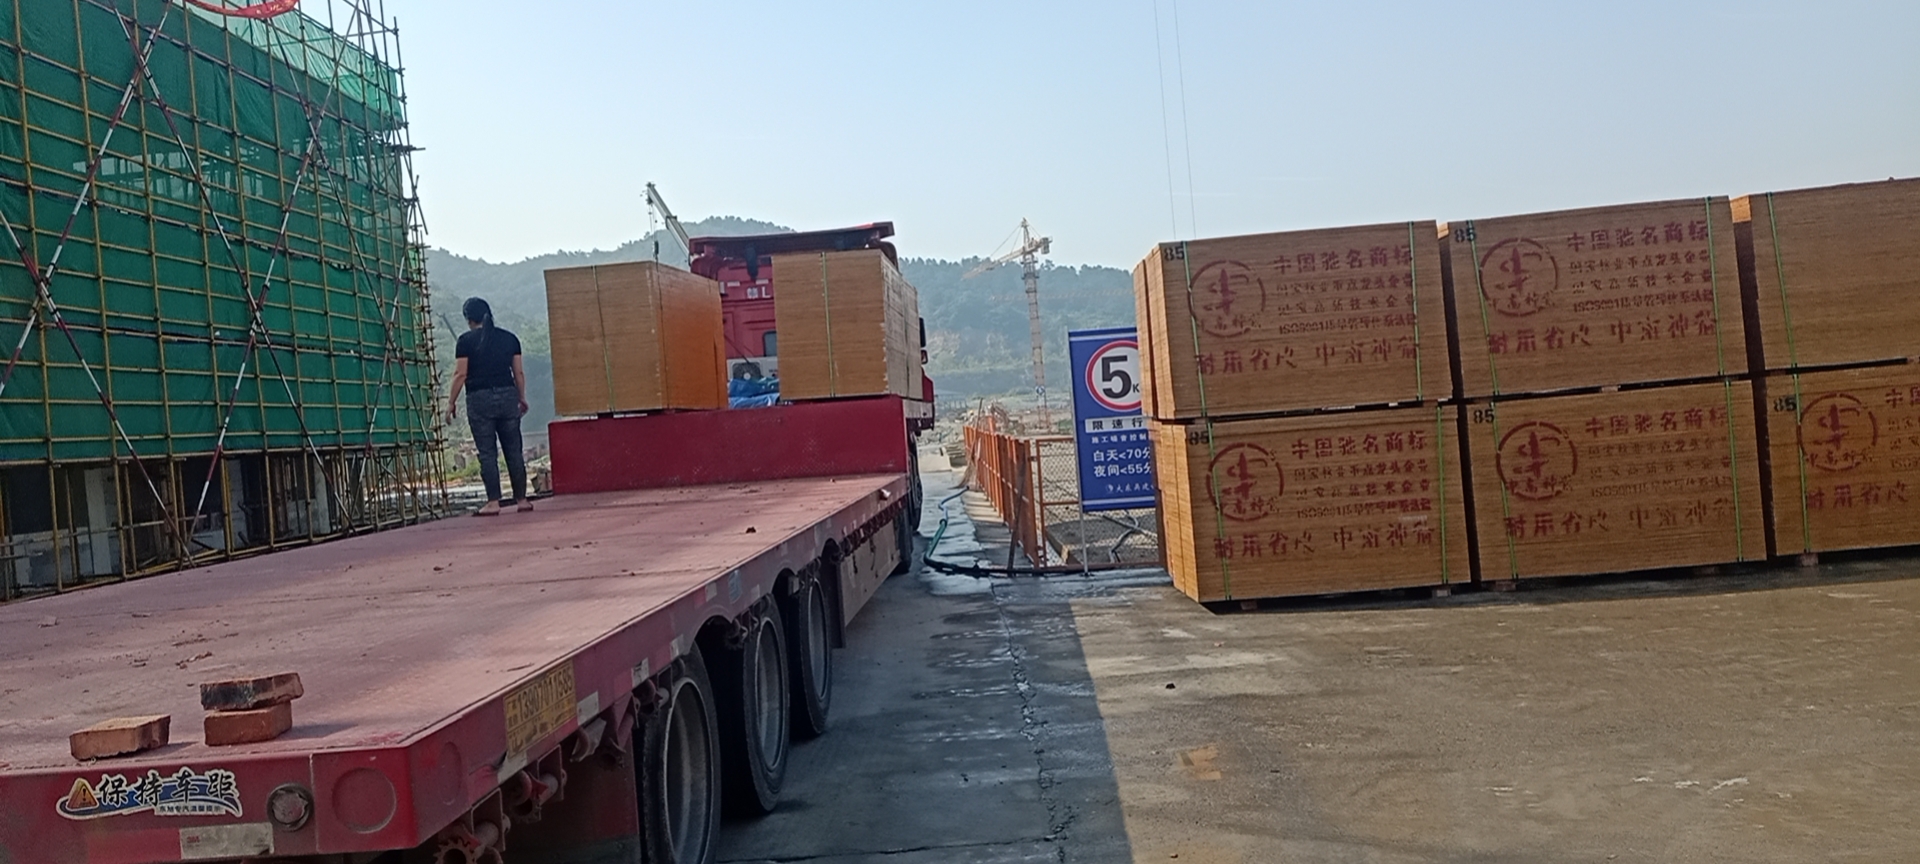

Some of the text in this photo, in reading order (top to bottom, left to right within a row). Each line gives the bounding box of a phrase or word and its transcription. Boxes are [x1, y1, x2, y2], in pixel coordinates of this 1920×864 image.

[1454, 228, 1476, 243] 85
[1567, 220, 1709, 252] 中国驰名商标
[1164, 246, 1185, 261] 85
[1273, 244, 1412, 275] 中国驰名商标
[1773, 397, 1797, 412] 85
[1092, 417, 1143, 430] 限速行
[1473, 409, 1494, 424] 85
[1585, 407, 1728, 438] 中国驰名商标
[1189, 431, 1210, 446] 85
[1292, 430, 1427, 460] 中国驰名商标
[1093, 446, 1151, 462] 白天<70分
[99, 770, 236, 806] 保持车距
